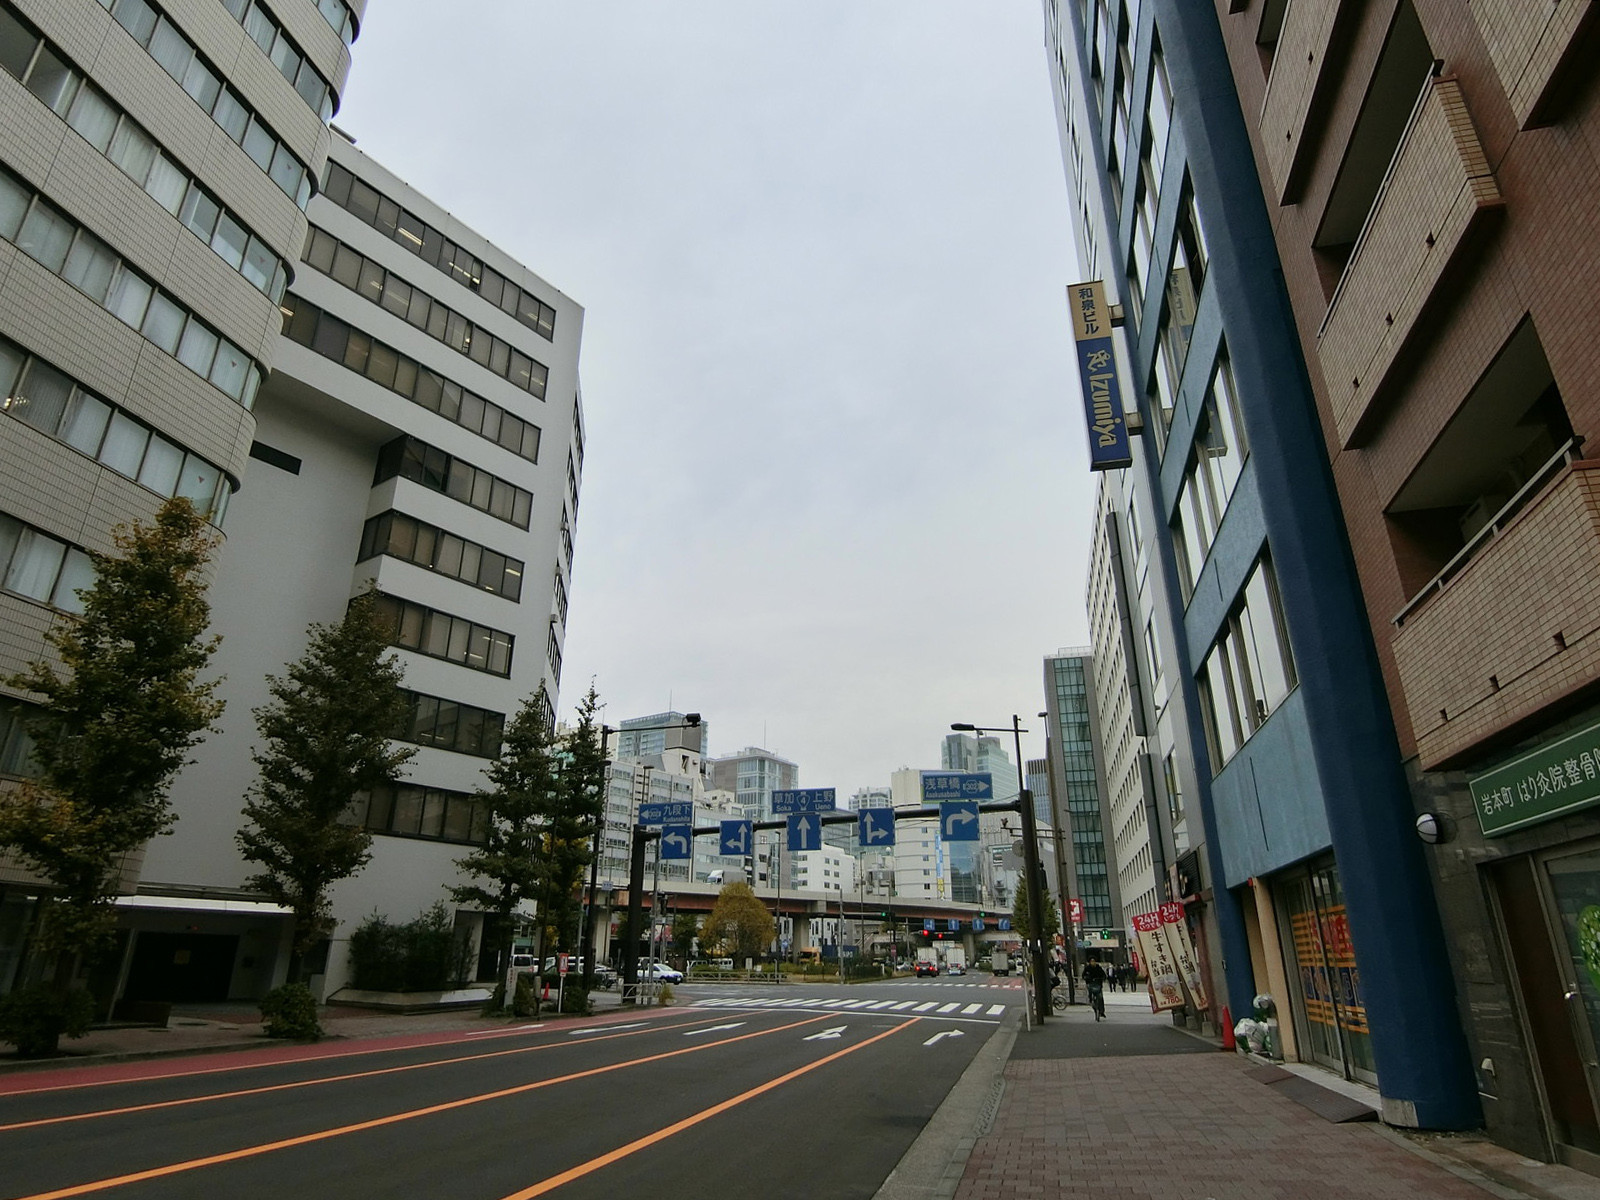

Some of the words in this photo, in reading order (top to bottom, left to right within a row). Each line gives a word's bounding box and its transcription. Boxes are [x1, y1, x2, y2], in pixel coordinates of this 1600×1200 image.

[1079, 287, 1099, 335] 和泉ビル
[1089, 373, 1121, 448] Izumiya
[925, 777, 961, 790] 浅草橋
[774, 792, 795, 804] 草加
[800, 797, 806, 805] 4
[812, 790, 833, 803] 上野
[1482, 786, 1514, 815] 岩本町
[663, 804, 691, 816] 九段下
[1161, 904, 1179, 916] 24H
[1137, 913, 1159, 925] 24H
[1151, 931, 1173, 975] 牛すき鍋
